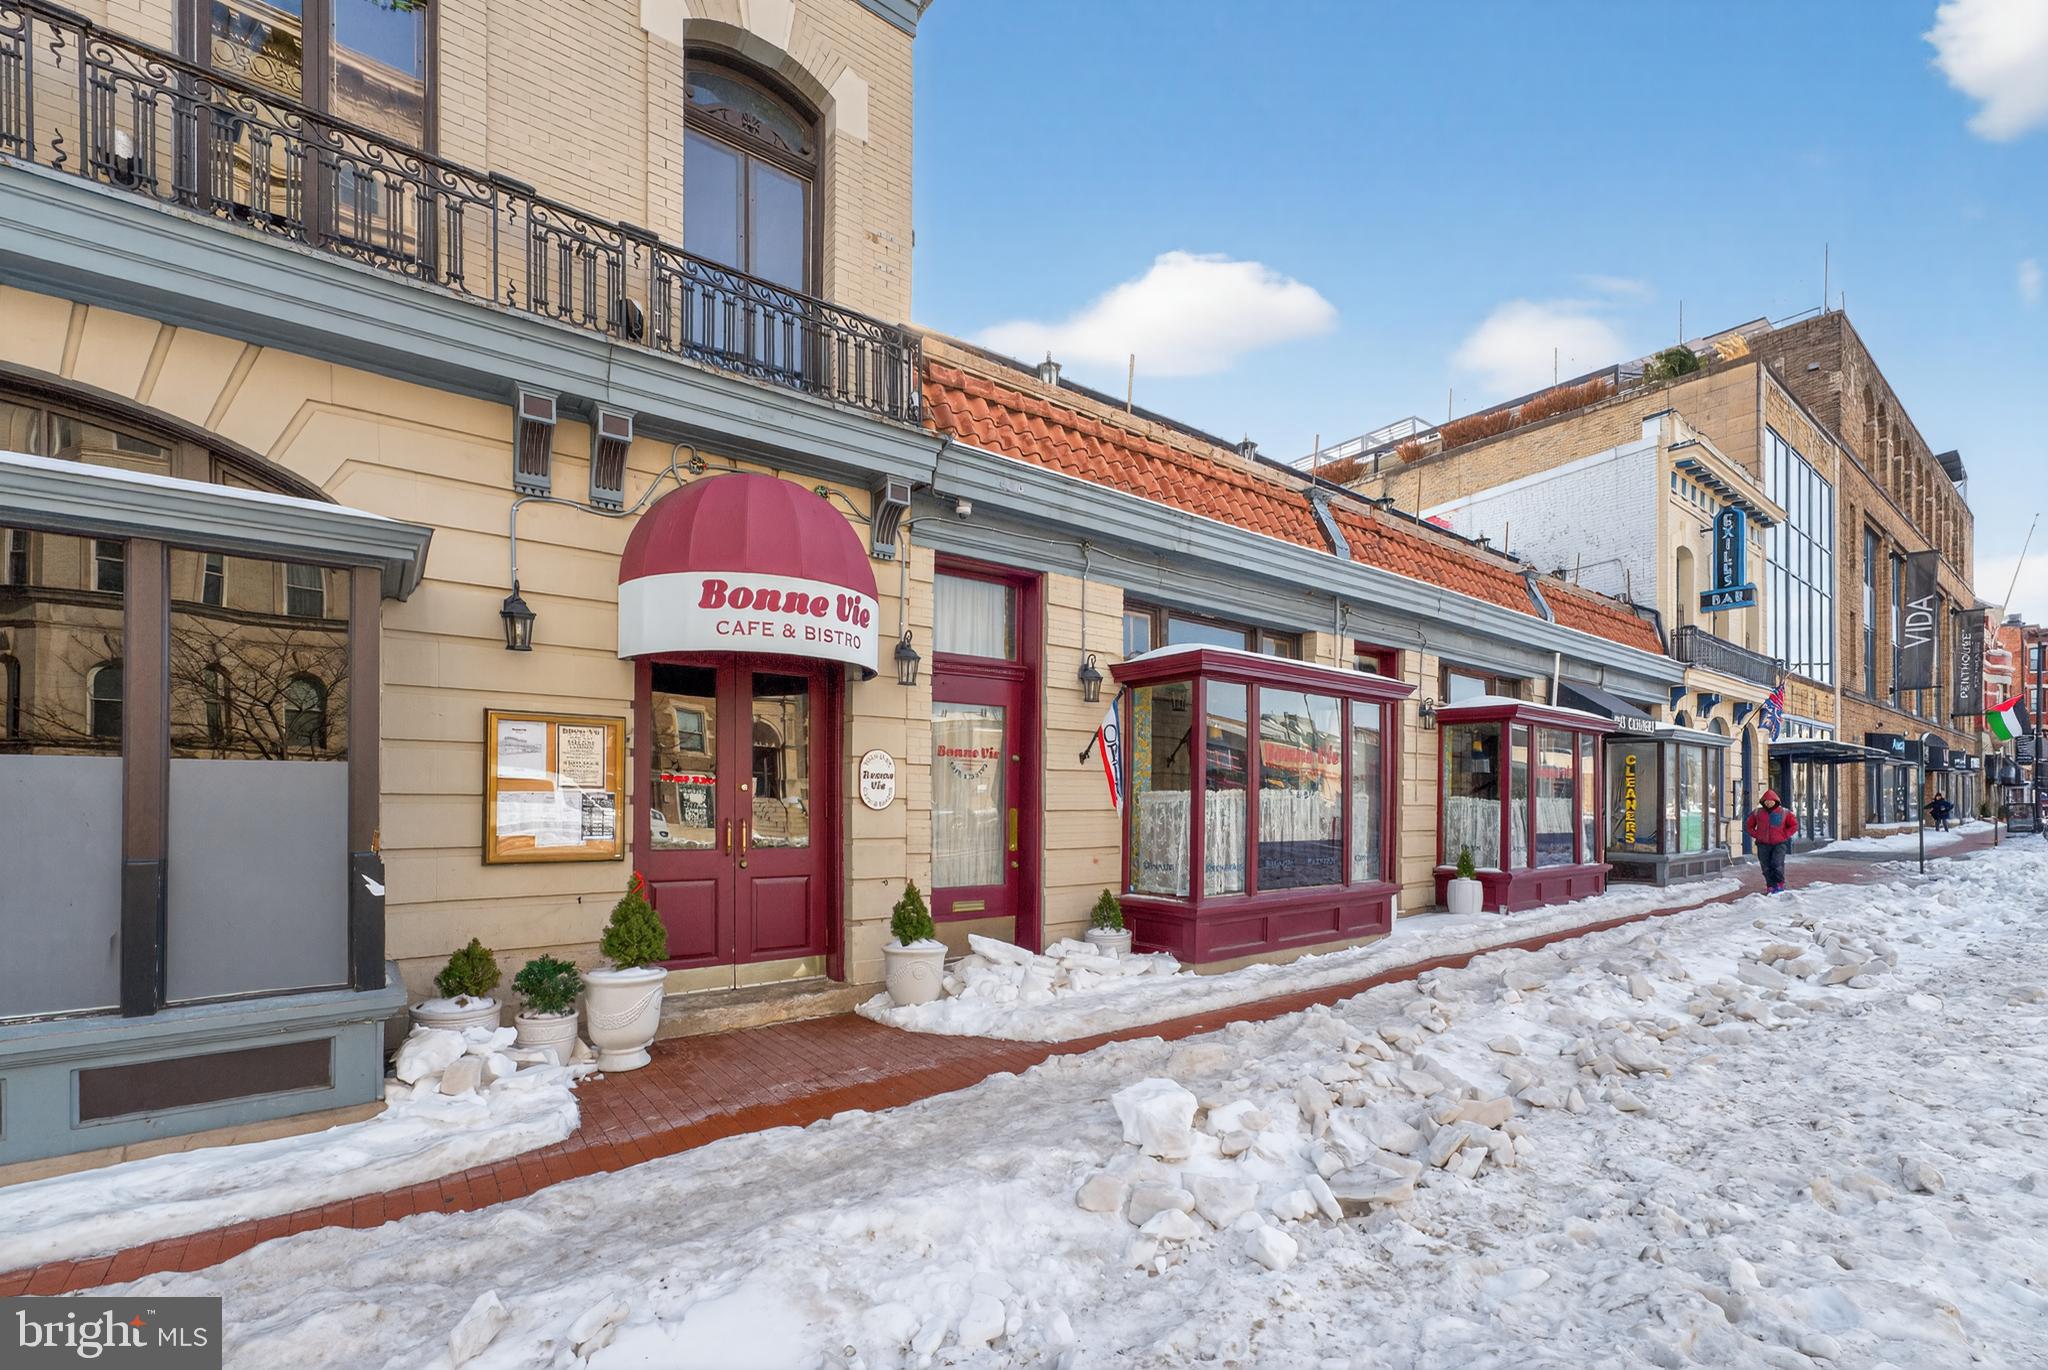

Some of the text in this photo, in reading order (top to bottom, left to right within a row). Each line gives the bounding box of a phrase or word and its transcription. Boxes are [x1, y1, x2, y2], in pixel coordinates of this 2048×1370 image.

[698, 579, 870, 629] Bonne Vie
[1904, 593, 1934, 649] VIDA
[716, 620, 861, 650] CAFE & BISTRO
[1103, 724, 1121, 798] OP
[1625, 754, 1637, 844] CLEANERS
